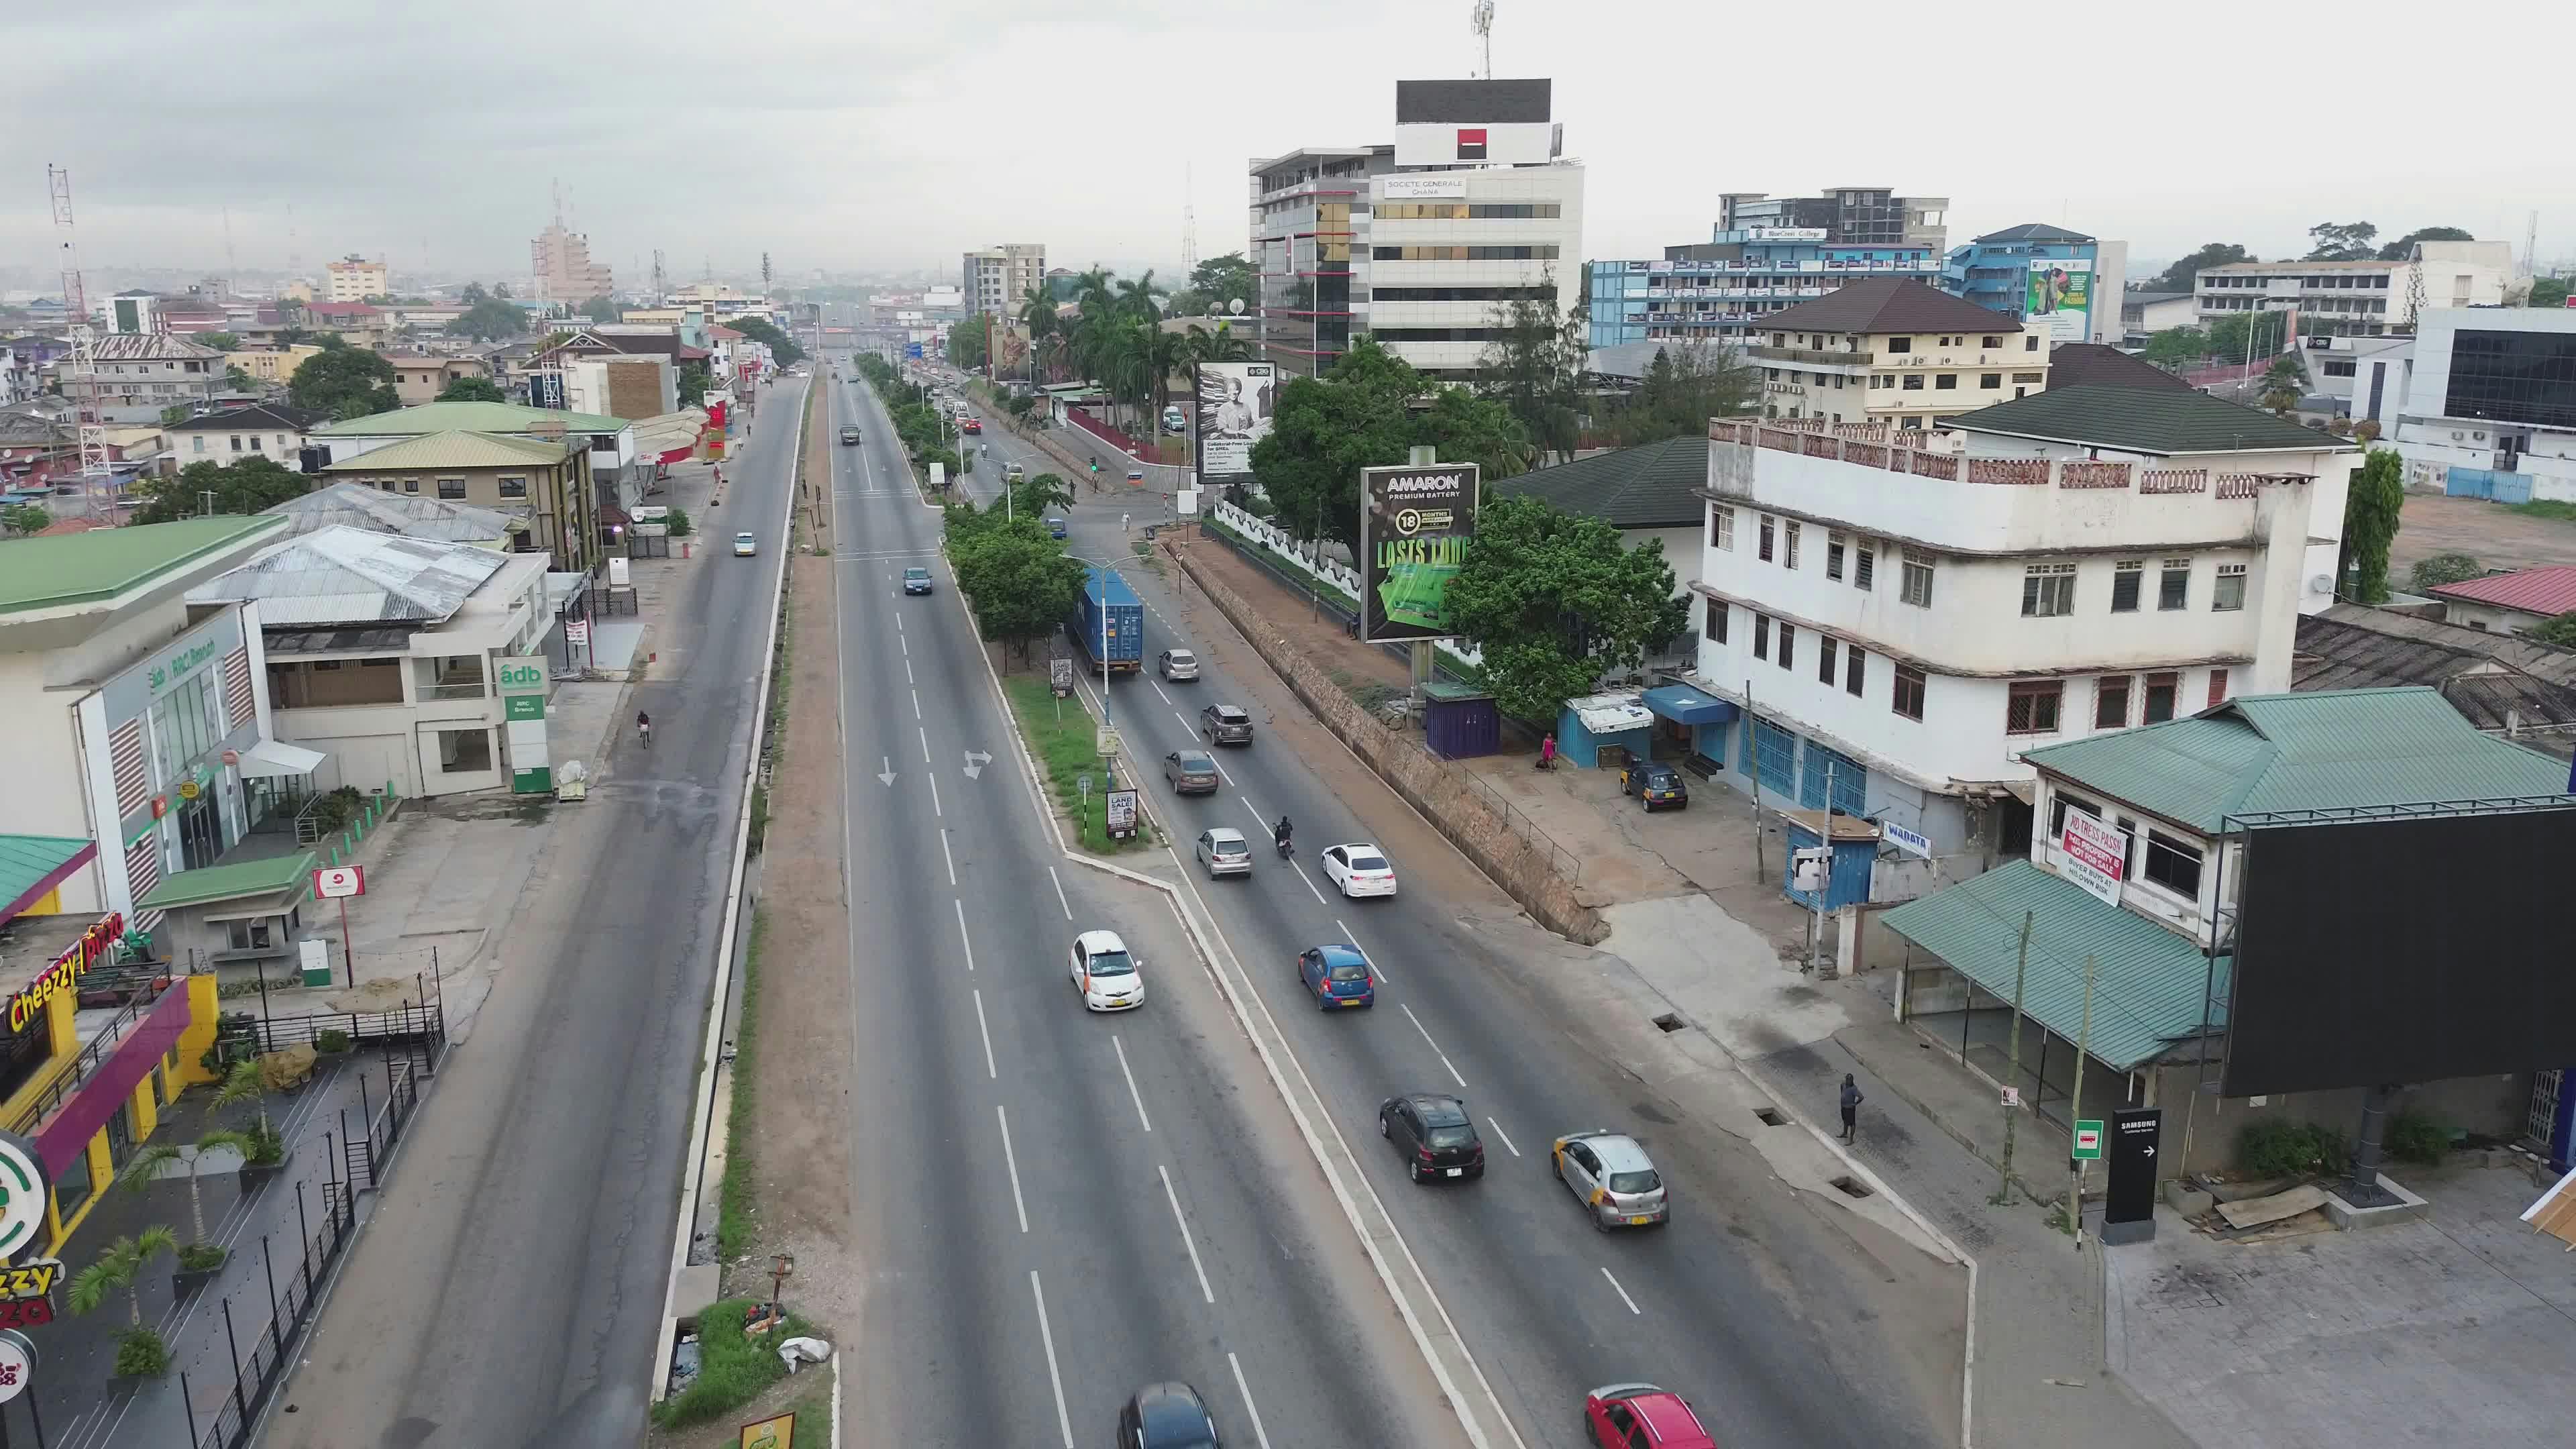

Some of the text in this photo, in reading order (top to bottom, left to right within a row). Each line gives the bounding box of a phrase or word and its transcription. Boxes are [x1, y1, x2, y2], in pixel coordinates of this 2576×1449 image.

[1387, 475, 1459, 492] AMARON
[1389, 492, 1425, 500] PREMIUM
[1401, 515, 1416, 528] 18
[1377, 539, 1426, 569] LASTS
[1888, 823, 1927, 849] WADATA
[2070, 814, 2080, 830] NO
[2081, 820, 2100, 842] TRESS
[2069, 833, 2120, 868] THIS PROPERTY IS
[2071, 845, 2114, 875] NOT FOR SALE
[2068, 857, 2112, 888] BUYER BUYS AT
[2069, 867, 2108, 896] HIS OWN RISK
[2121, 1120, 2157, 1130] SAMSUNG
